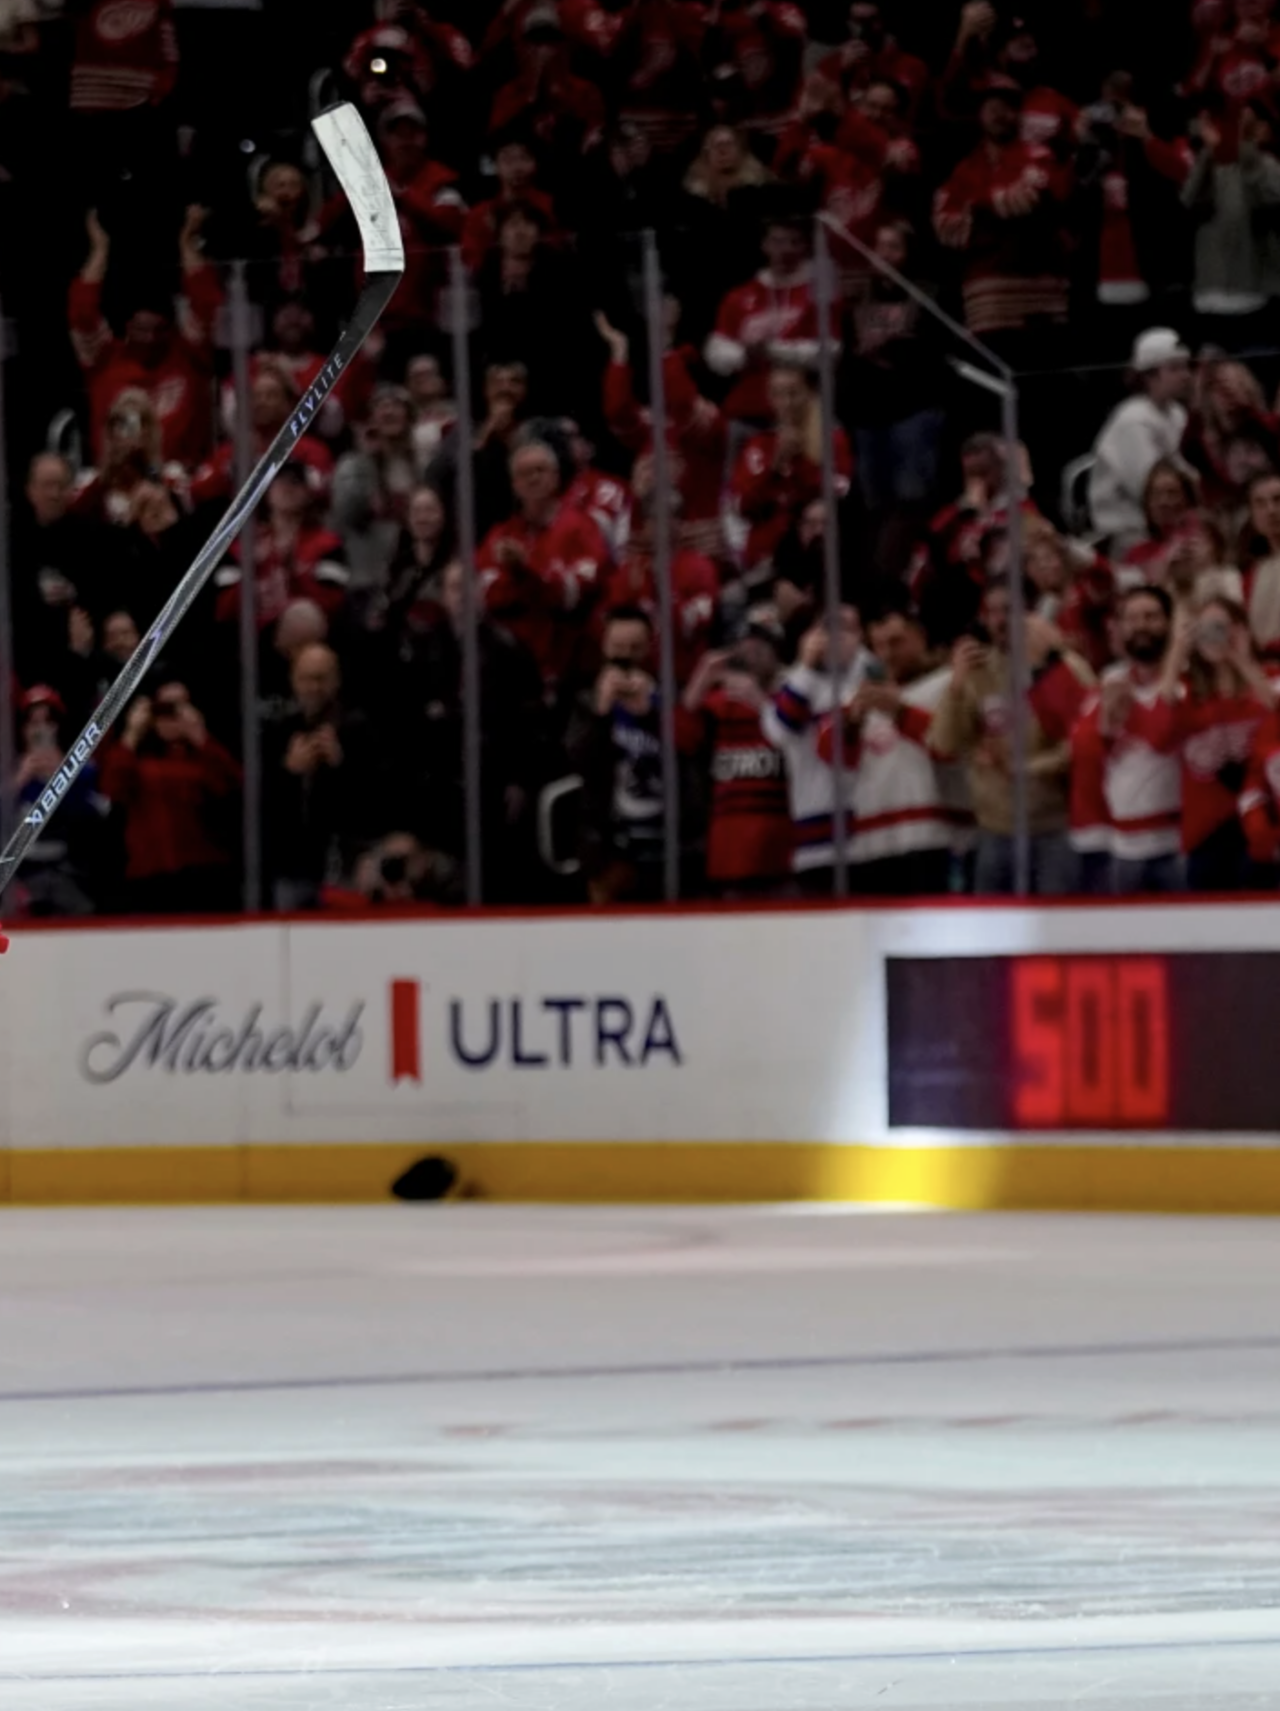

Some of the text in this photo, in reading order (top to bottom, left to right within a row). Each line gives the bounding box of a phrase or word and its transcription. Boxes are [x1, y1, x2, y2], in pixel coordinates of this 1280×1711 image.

[289, 352, 344, 437] FLYLITE
[40, 721, 101, 813] BAUER
[78, 990, 683, 1085] Michelob ULTRA
[1013, 957, 1168, 1123] 500
